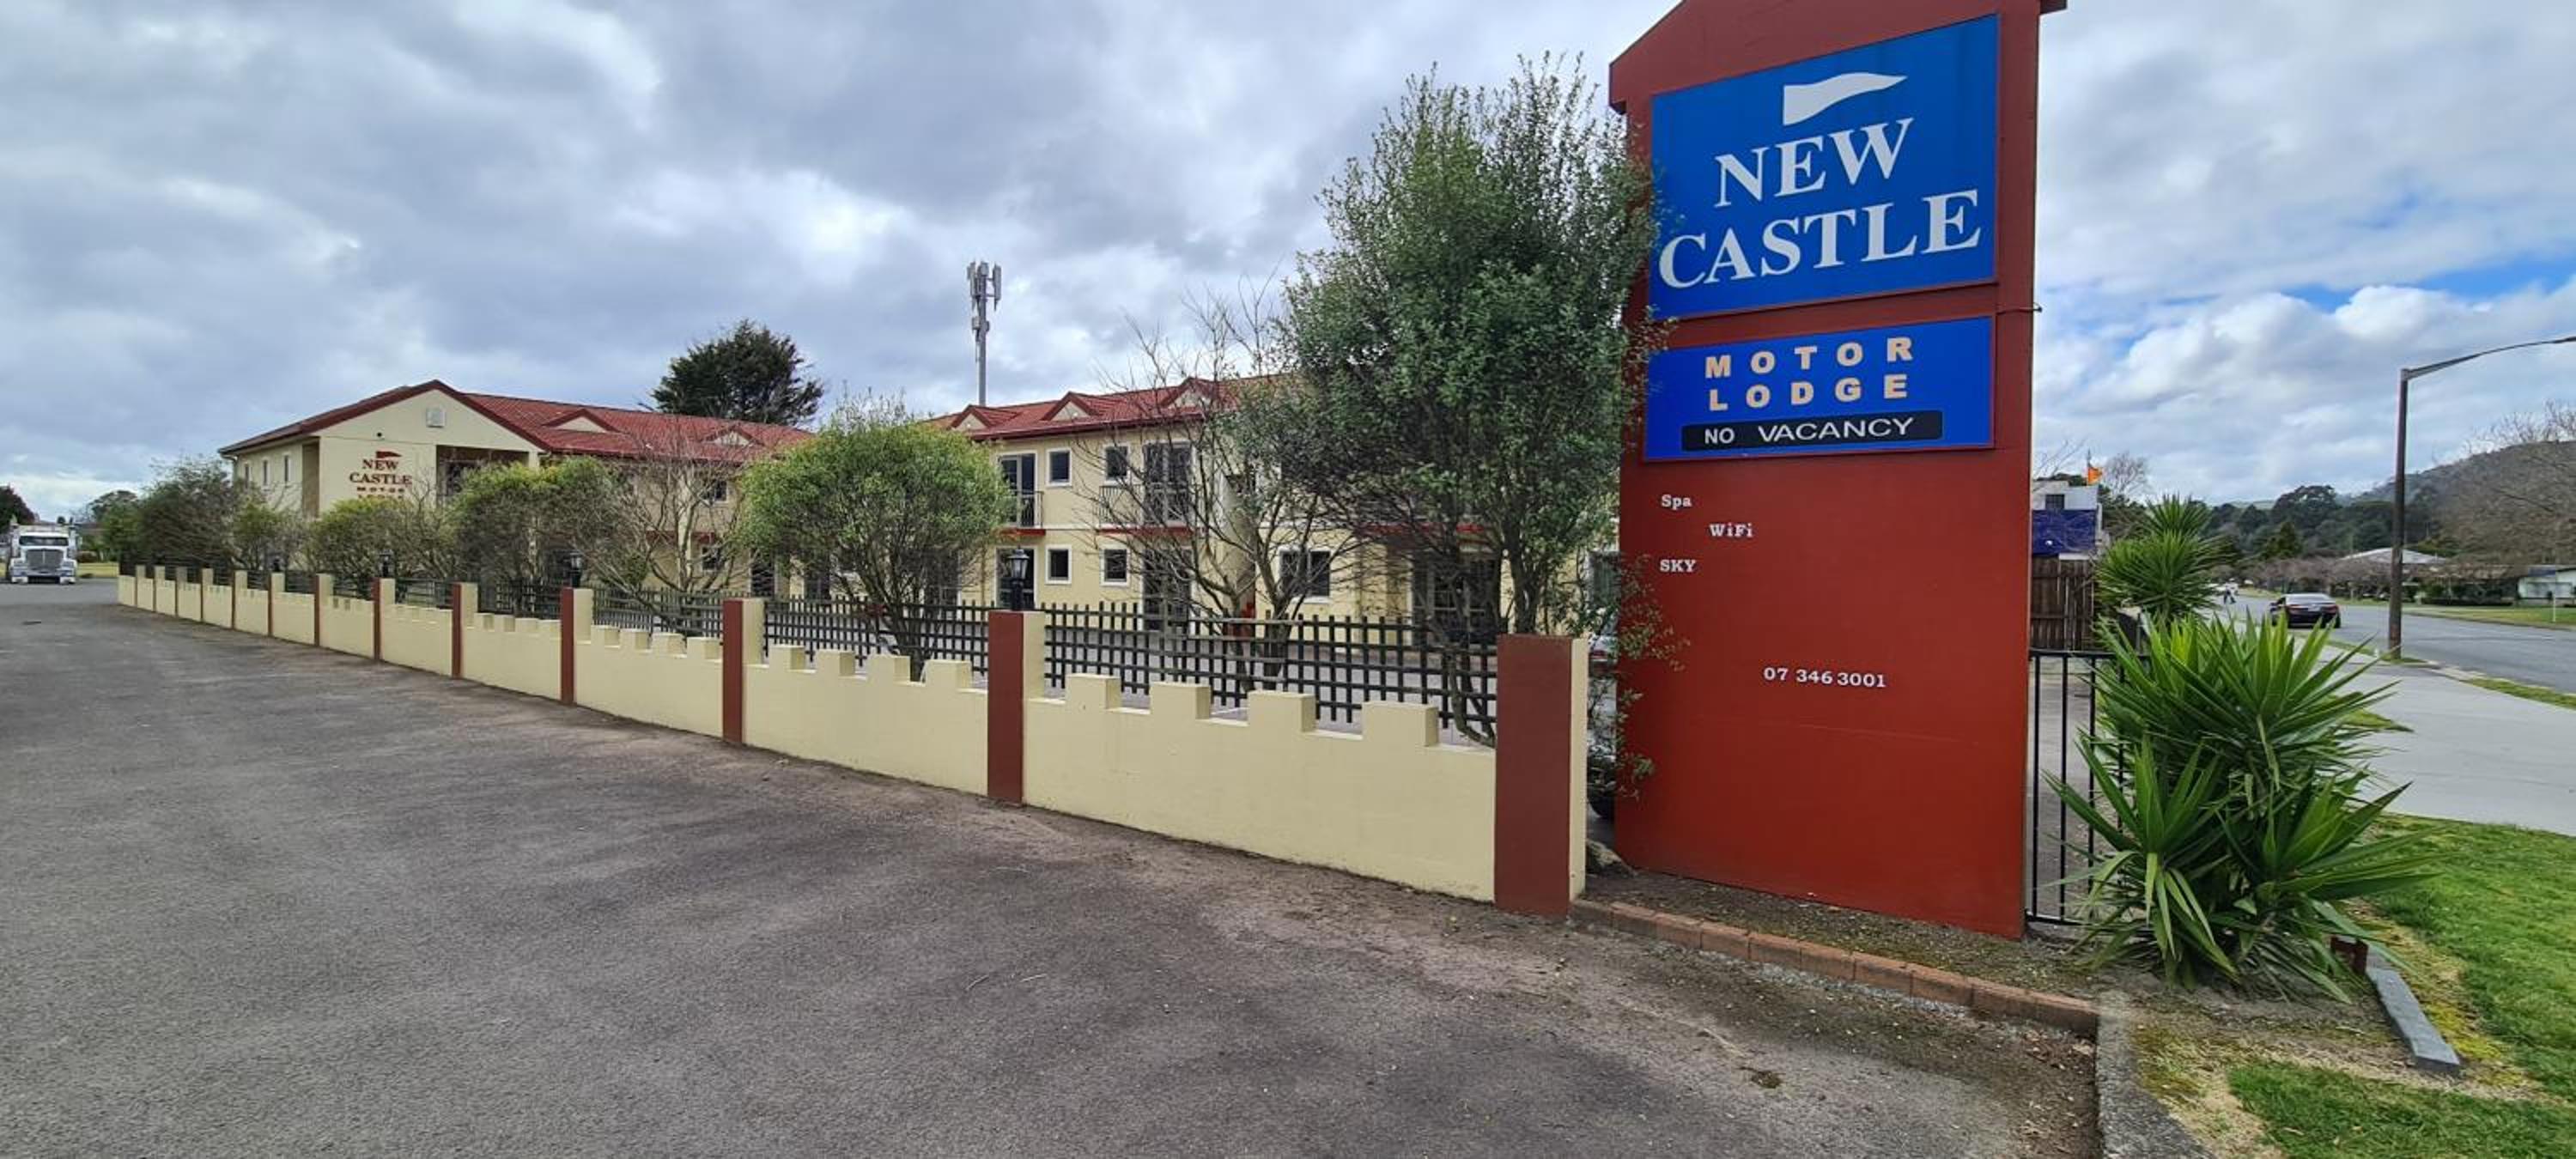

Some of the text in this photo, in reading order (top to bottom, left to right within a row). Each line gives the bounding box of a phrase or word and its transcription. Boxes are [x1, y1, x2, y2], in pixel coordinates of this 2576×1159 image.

[1713, 117, 1914, 208] NEW
[1658, 189, 1981, 289] CASTLE
[1704, 337, 1914, 379] MOTOR
[1709, 373, 1908, 411] LODGE
[1704, 416, 1915, 445] NO VACANCY
[362, 459, 398, 470] NEW
[349, 472, 412, 484] CASTLE
[1661, 494, 1693, 510] Spa
[1709, 523, 1754, 537] WiFi
[1659, 558, 1697, 573] SKY
[1763, 667, 1886, 688] 07 346 3001
